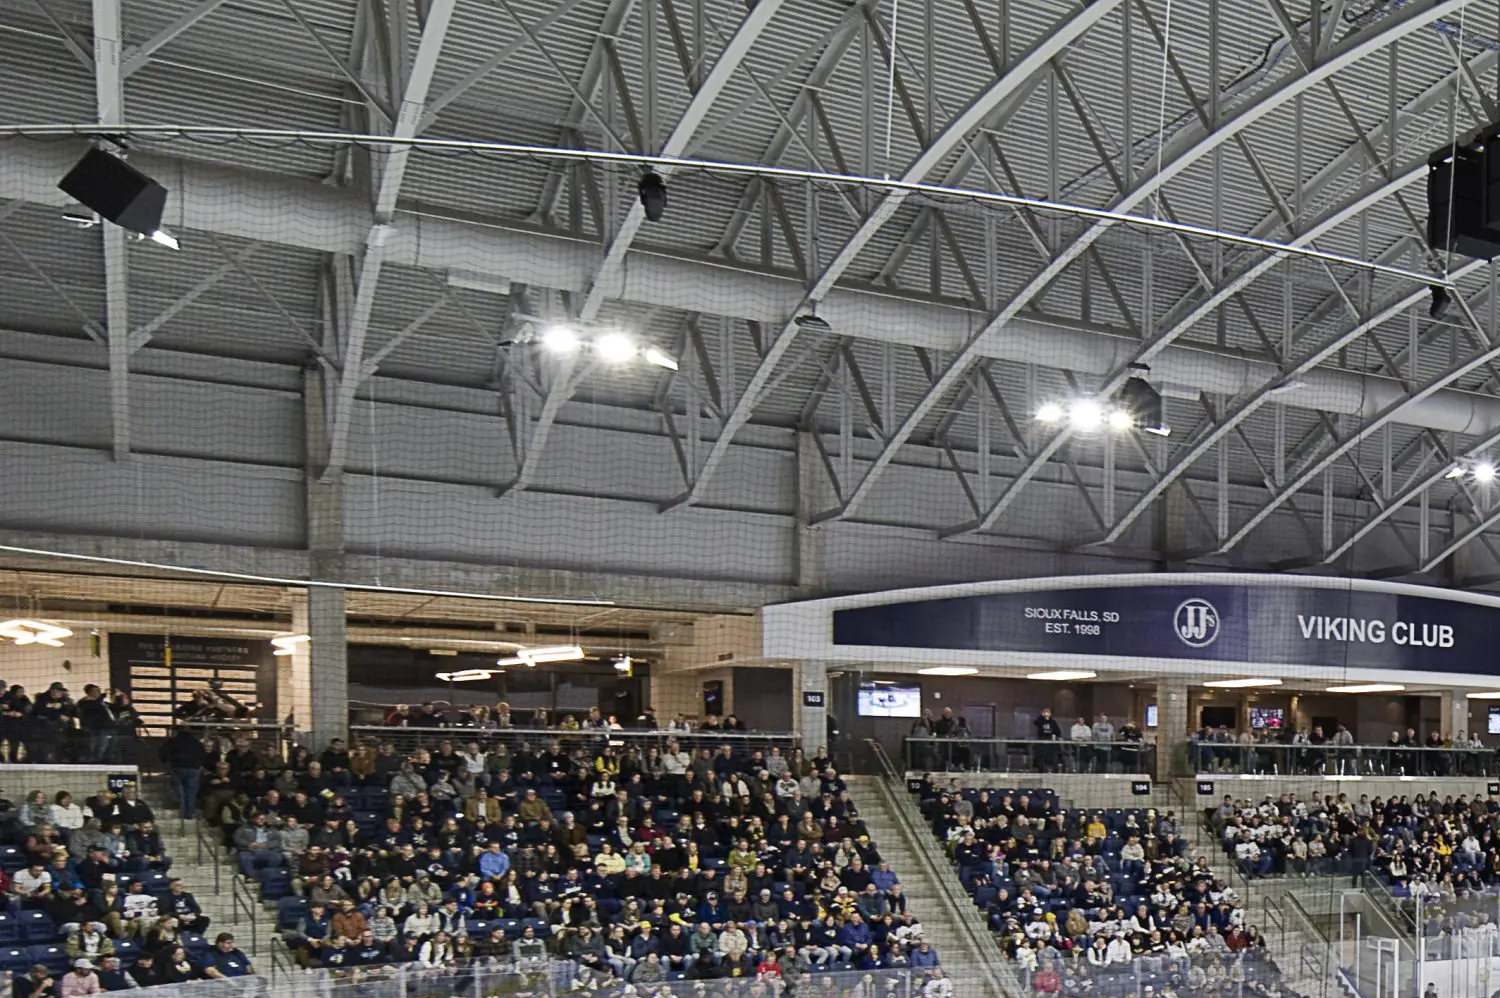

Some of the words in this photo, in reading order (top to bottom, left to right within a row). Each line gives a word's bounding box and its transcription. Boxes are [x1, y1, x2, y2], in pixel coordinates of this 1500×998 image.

[1025, 607, 1061, 621] SIOUX
[1102, 611, 1119, 623] SD
[1045, 622, 1071, 635] EST.
[1075, 623, 1100, 636] 1998
[1298, 614, 1386, 644] VIKING
[1392, 621, 1454, 648] CLUB
[807, 695, 821, 703] 103
